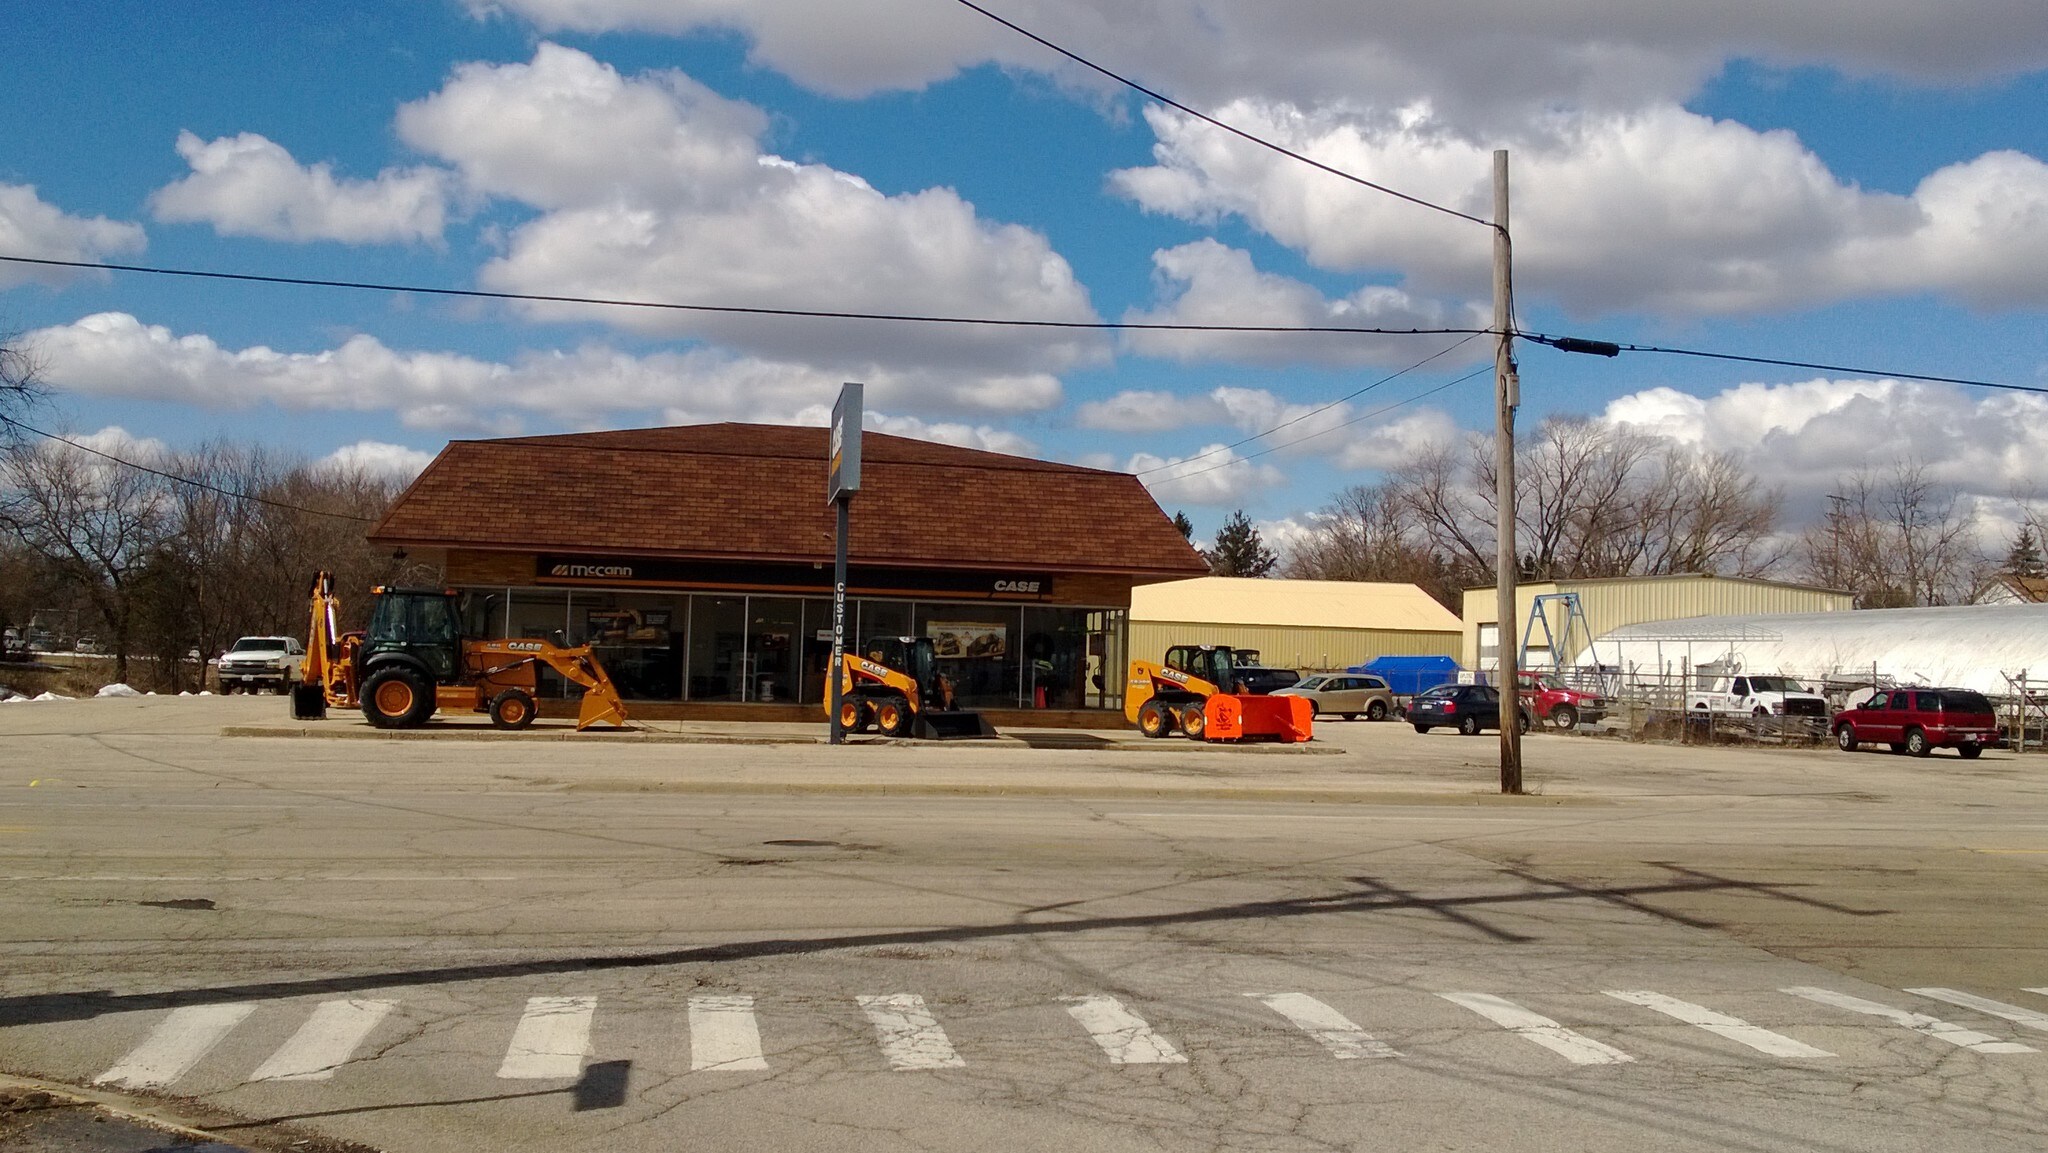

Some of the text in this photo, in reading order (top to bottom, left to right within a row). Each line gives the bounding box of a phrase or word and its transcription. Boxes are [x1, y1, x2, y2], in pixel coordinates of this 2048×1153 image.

[994, 580, 1040, 592] CASE
[835, 582, 844, 667] CUSTOMER
[508, 642, 542, 651] CASE
[860, 661, 888, 678] CASE
[1160, 668, 1189, 683] CASE
